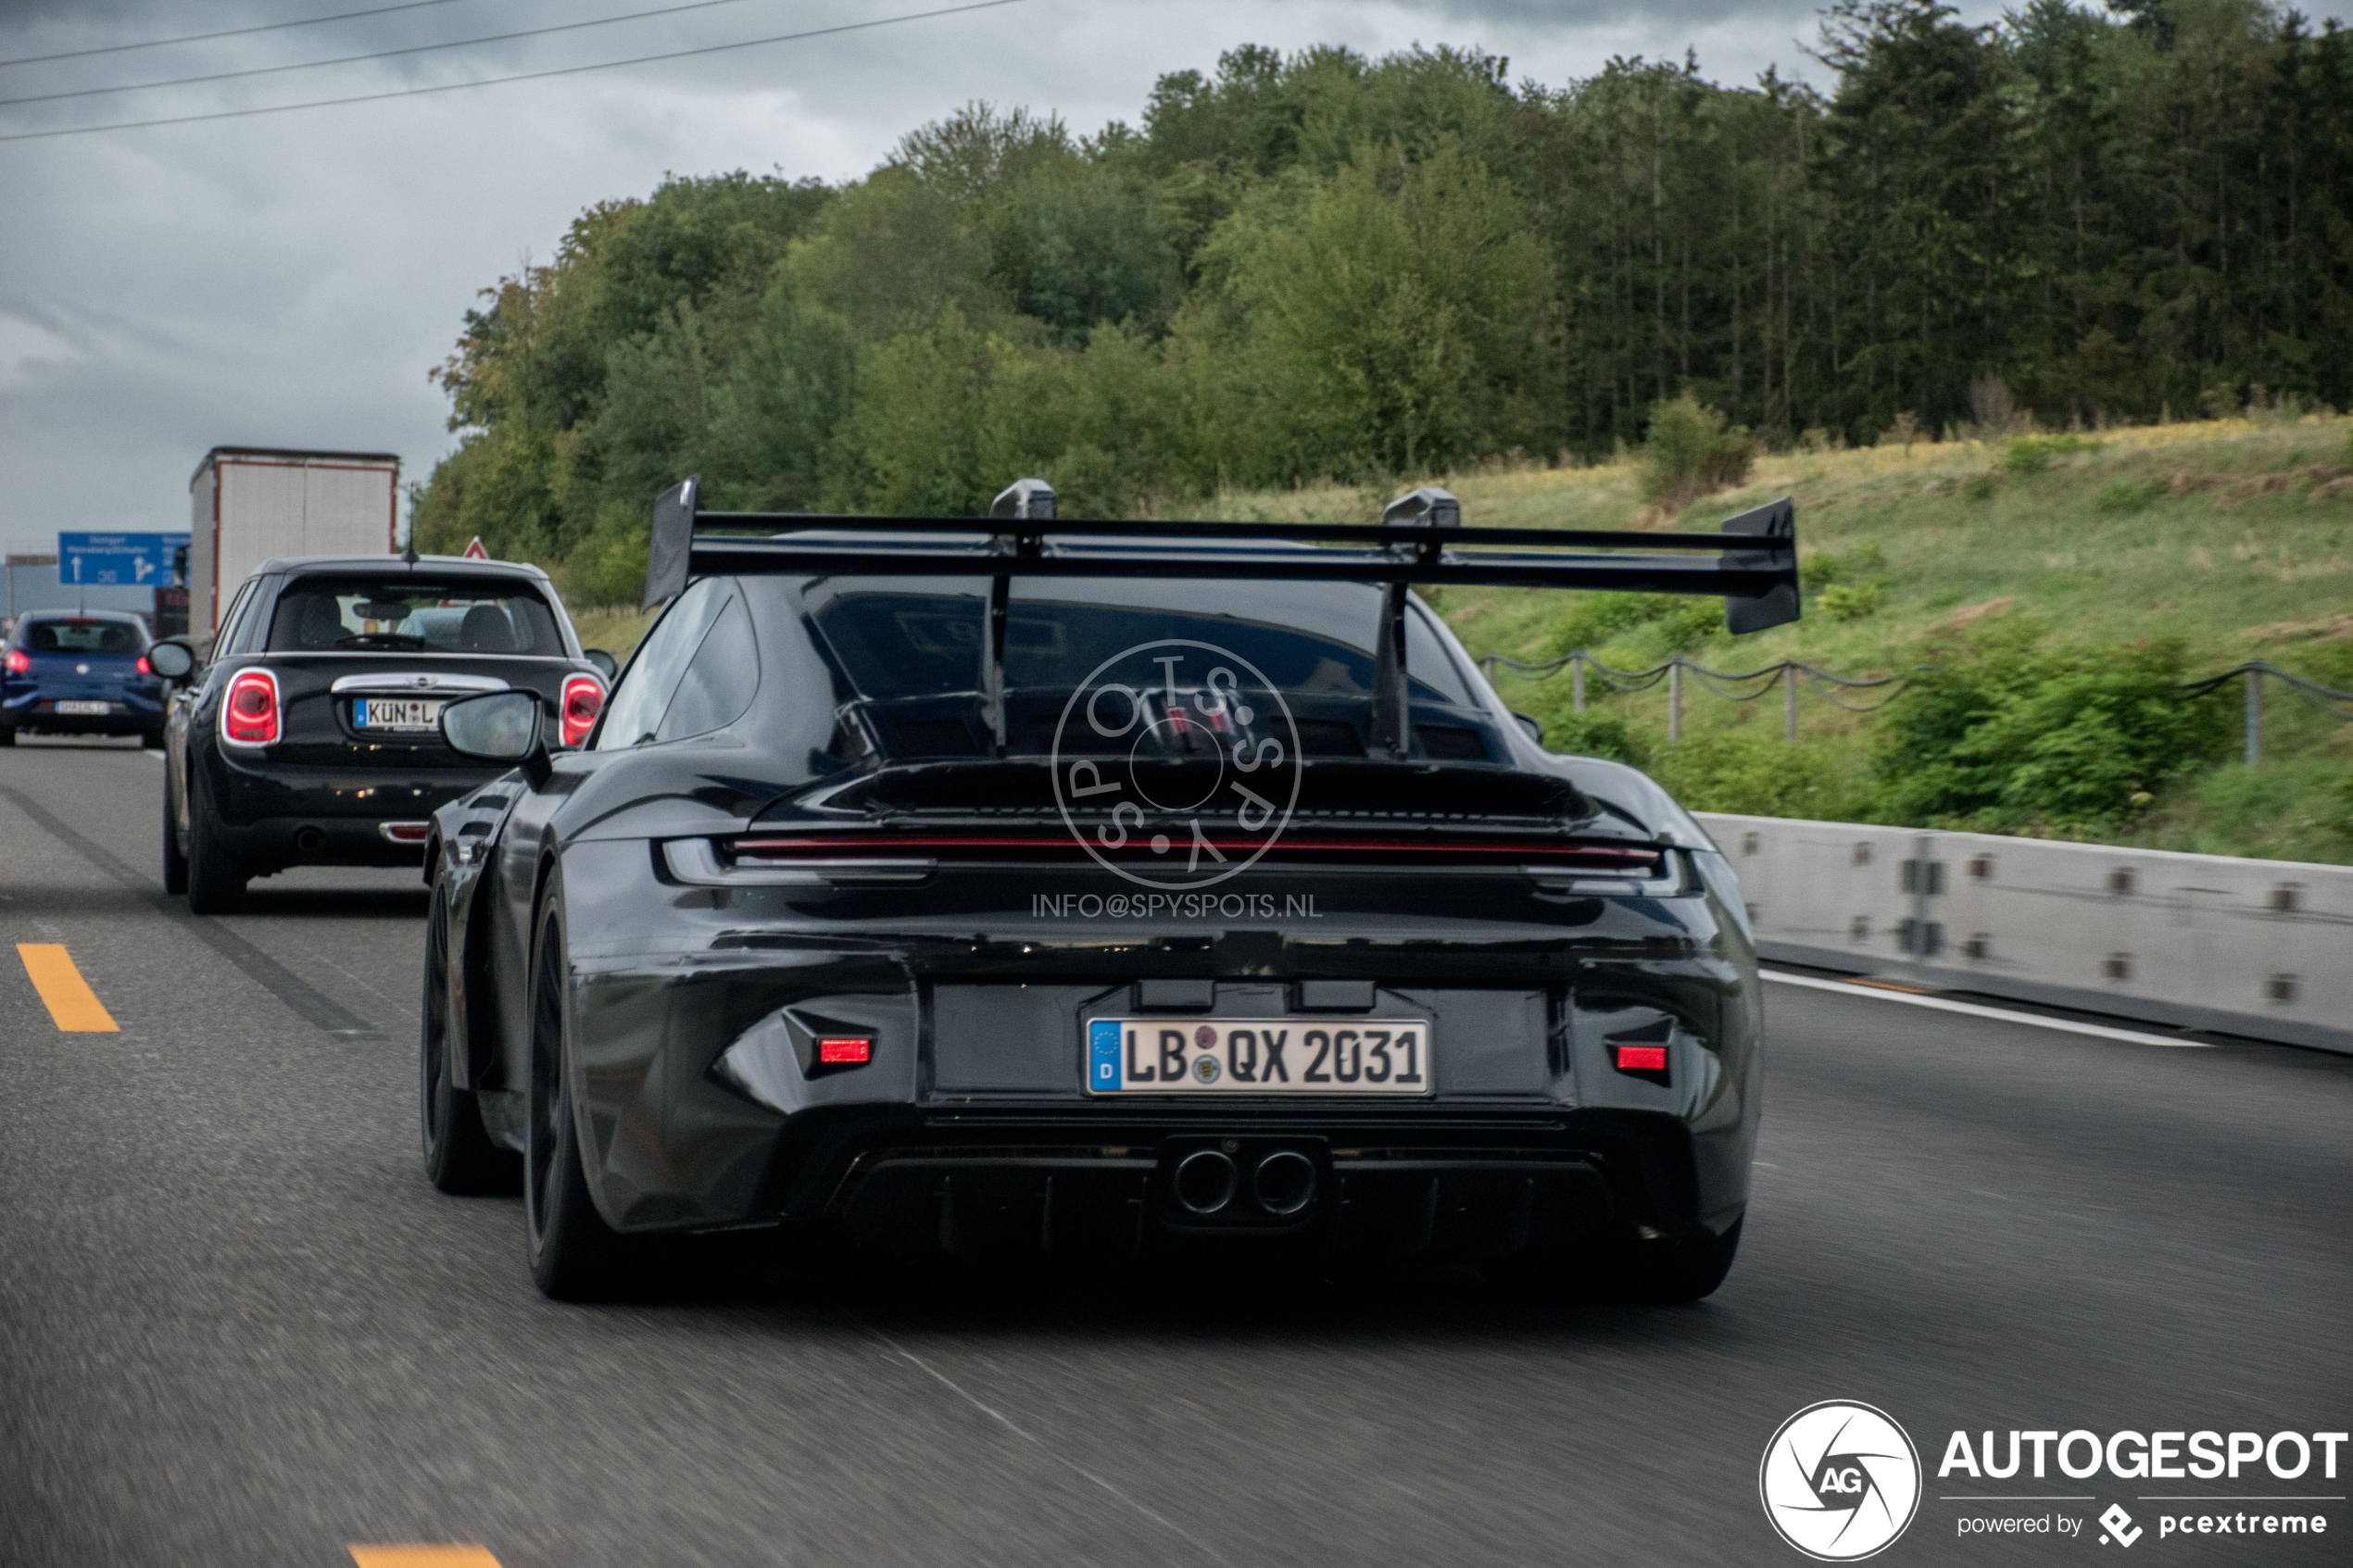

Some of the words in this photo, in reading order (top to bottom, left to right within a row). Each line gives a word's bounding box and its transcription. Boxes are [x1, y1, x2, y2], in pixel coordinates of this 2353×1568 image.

[369, 703, 406, 722] KÜN
[422, 704, 434, 722] L
[1100, 1063, 1114, 1079] D
[1126, 1030, 1187, 1082] LB
[1228, 1030, 1289, 1082] QX
[1303, 1030, 1421, 1083] 2031
